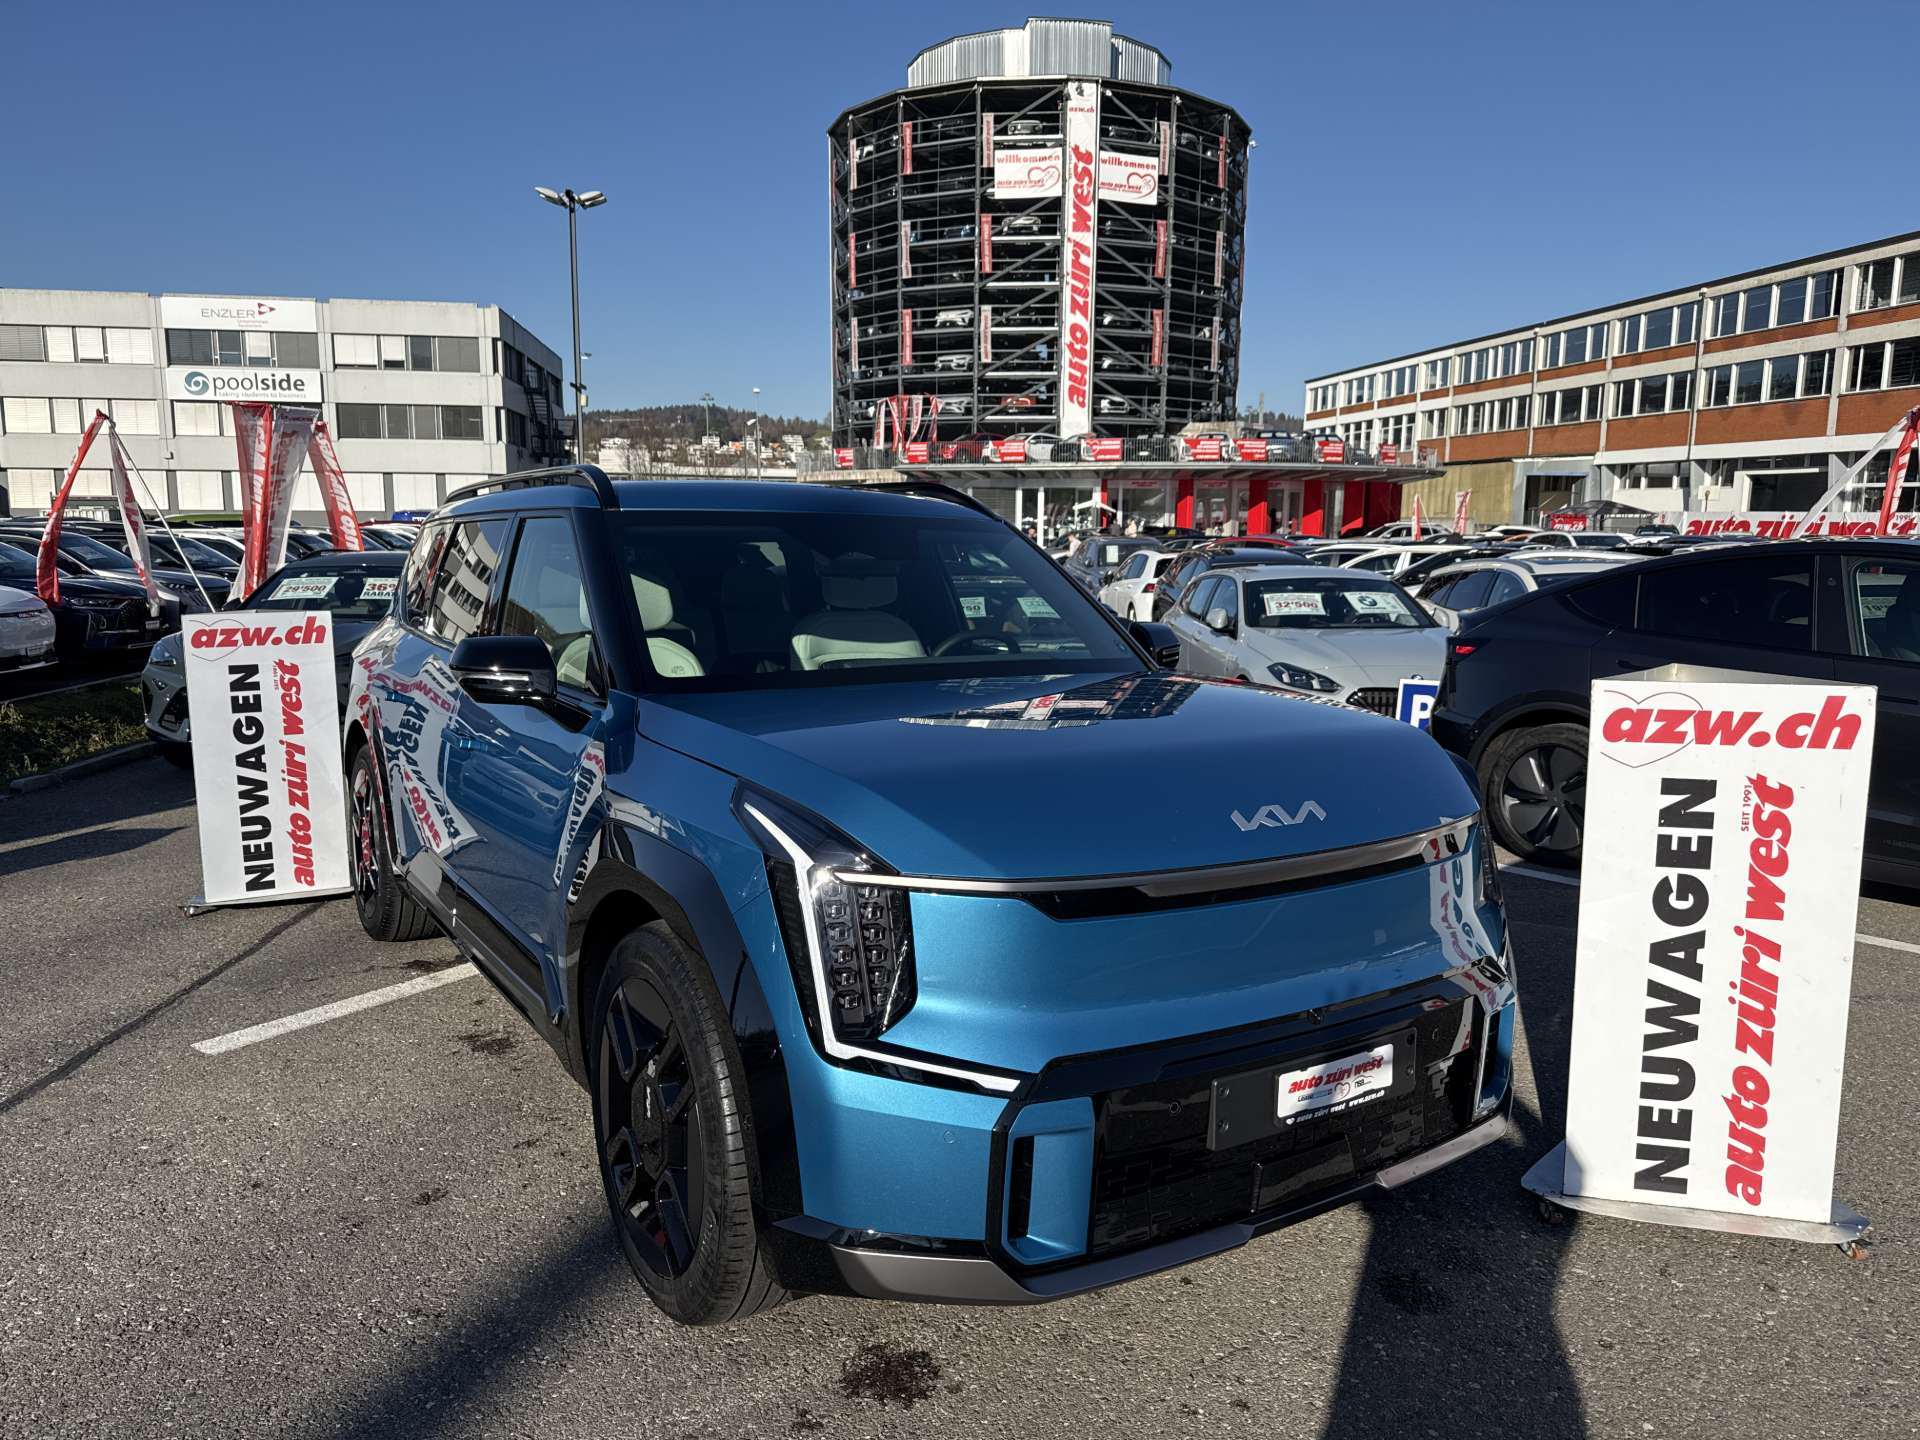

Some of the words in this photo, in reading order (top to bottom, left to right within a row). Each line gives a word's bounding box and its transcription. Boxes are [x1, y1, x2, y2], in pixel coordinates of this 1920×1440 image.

[997, 153, 1060, 165] willkommen
[1100, 158, 1157, 171] willkommen
[1071, 144, 1094, 233] west
[1067, 237, 1091, 322] züri
[201, 308, 256, 319] ENZLER
[213, 372, 305, 397] poolside
[1066, 322, 1089, 408] auto
[219, 391, 239, 399] taking
[1685, 515, 1751, 536] auto
[1829, 515, 1917, 536] wet
[191, 616, 327, 649] azw.ch
[273, 659, 305, 736] west
[1410, 694, 1436, 728] P
[1602, 695, 1862, 751] azw.ch
[228, 663, 276, 892] NEUWAGEN
[279, 739, 310, 812] züri
[1742, 784, 1752, 808] 1991
[1230, 800, 1327, 832] KIA
[1740, 811, 1750, 832] SEIT
[286, 812, 316, 887] auto
[1744, 772, 1796, 922] west
[1634, 777, 1719, 1195] NEUWAGEN
[1727, 925, 1782, 1067] züri
[1287, 1074, 1324, 1094] auto
[1323, 1064, 1353, 1086] züri
[1353, 1055, 1384, 1077] west
[1724, 1065, 1771, 1207] auto
